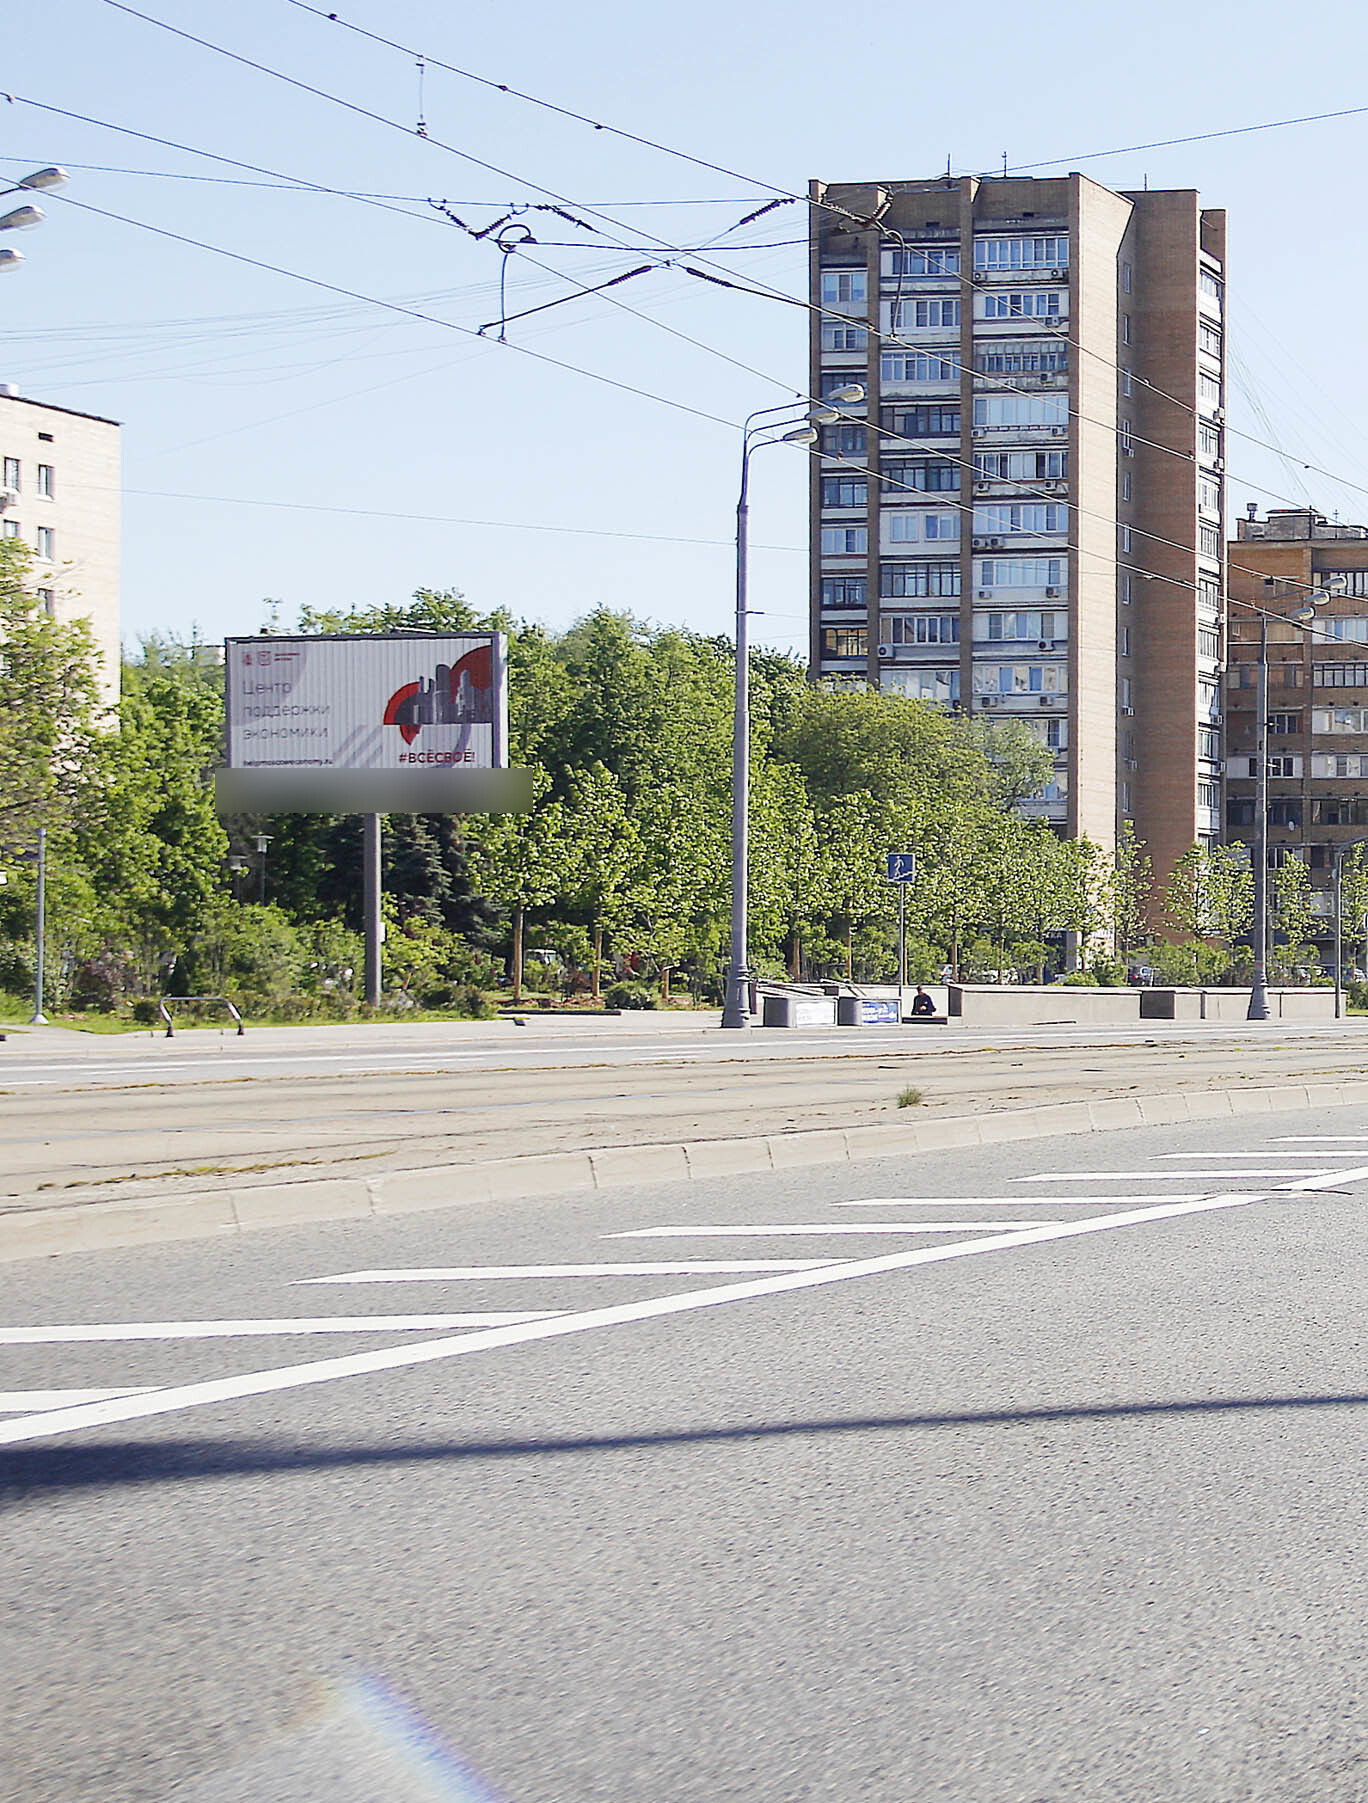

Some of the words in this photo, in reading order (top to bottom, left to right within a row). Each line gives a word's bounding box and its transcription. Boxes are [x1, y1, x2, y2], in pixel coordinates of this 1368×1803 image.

[243, 680, 292, 698] Центр
[243, 705, 330, 719] поддержки
[243, 728, 328, 740] экономики
